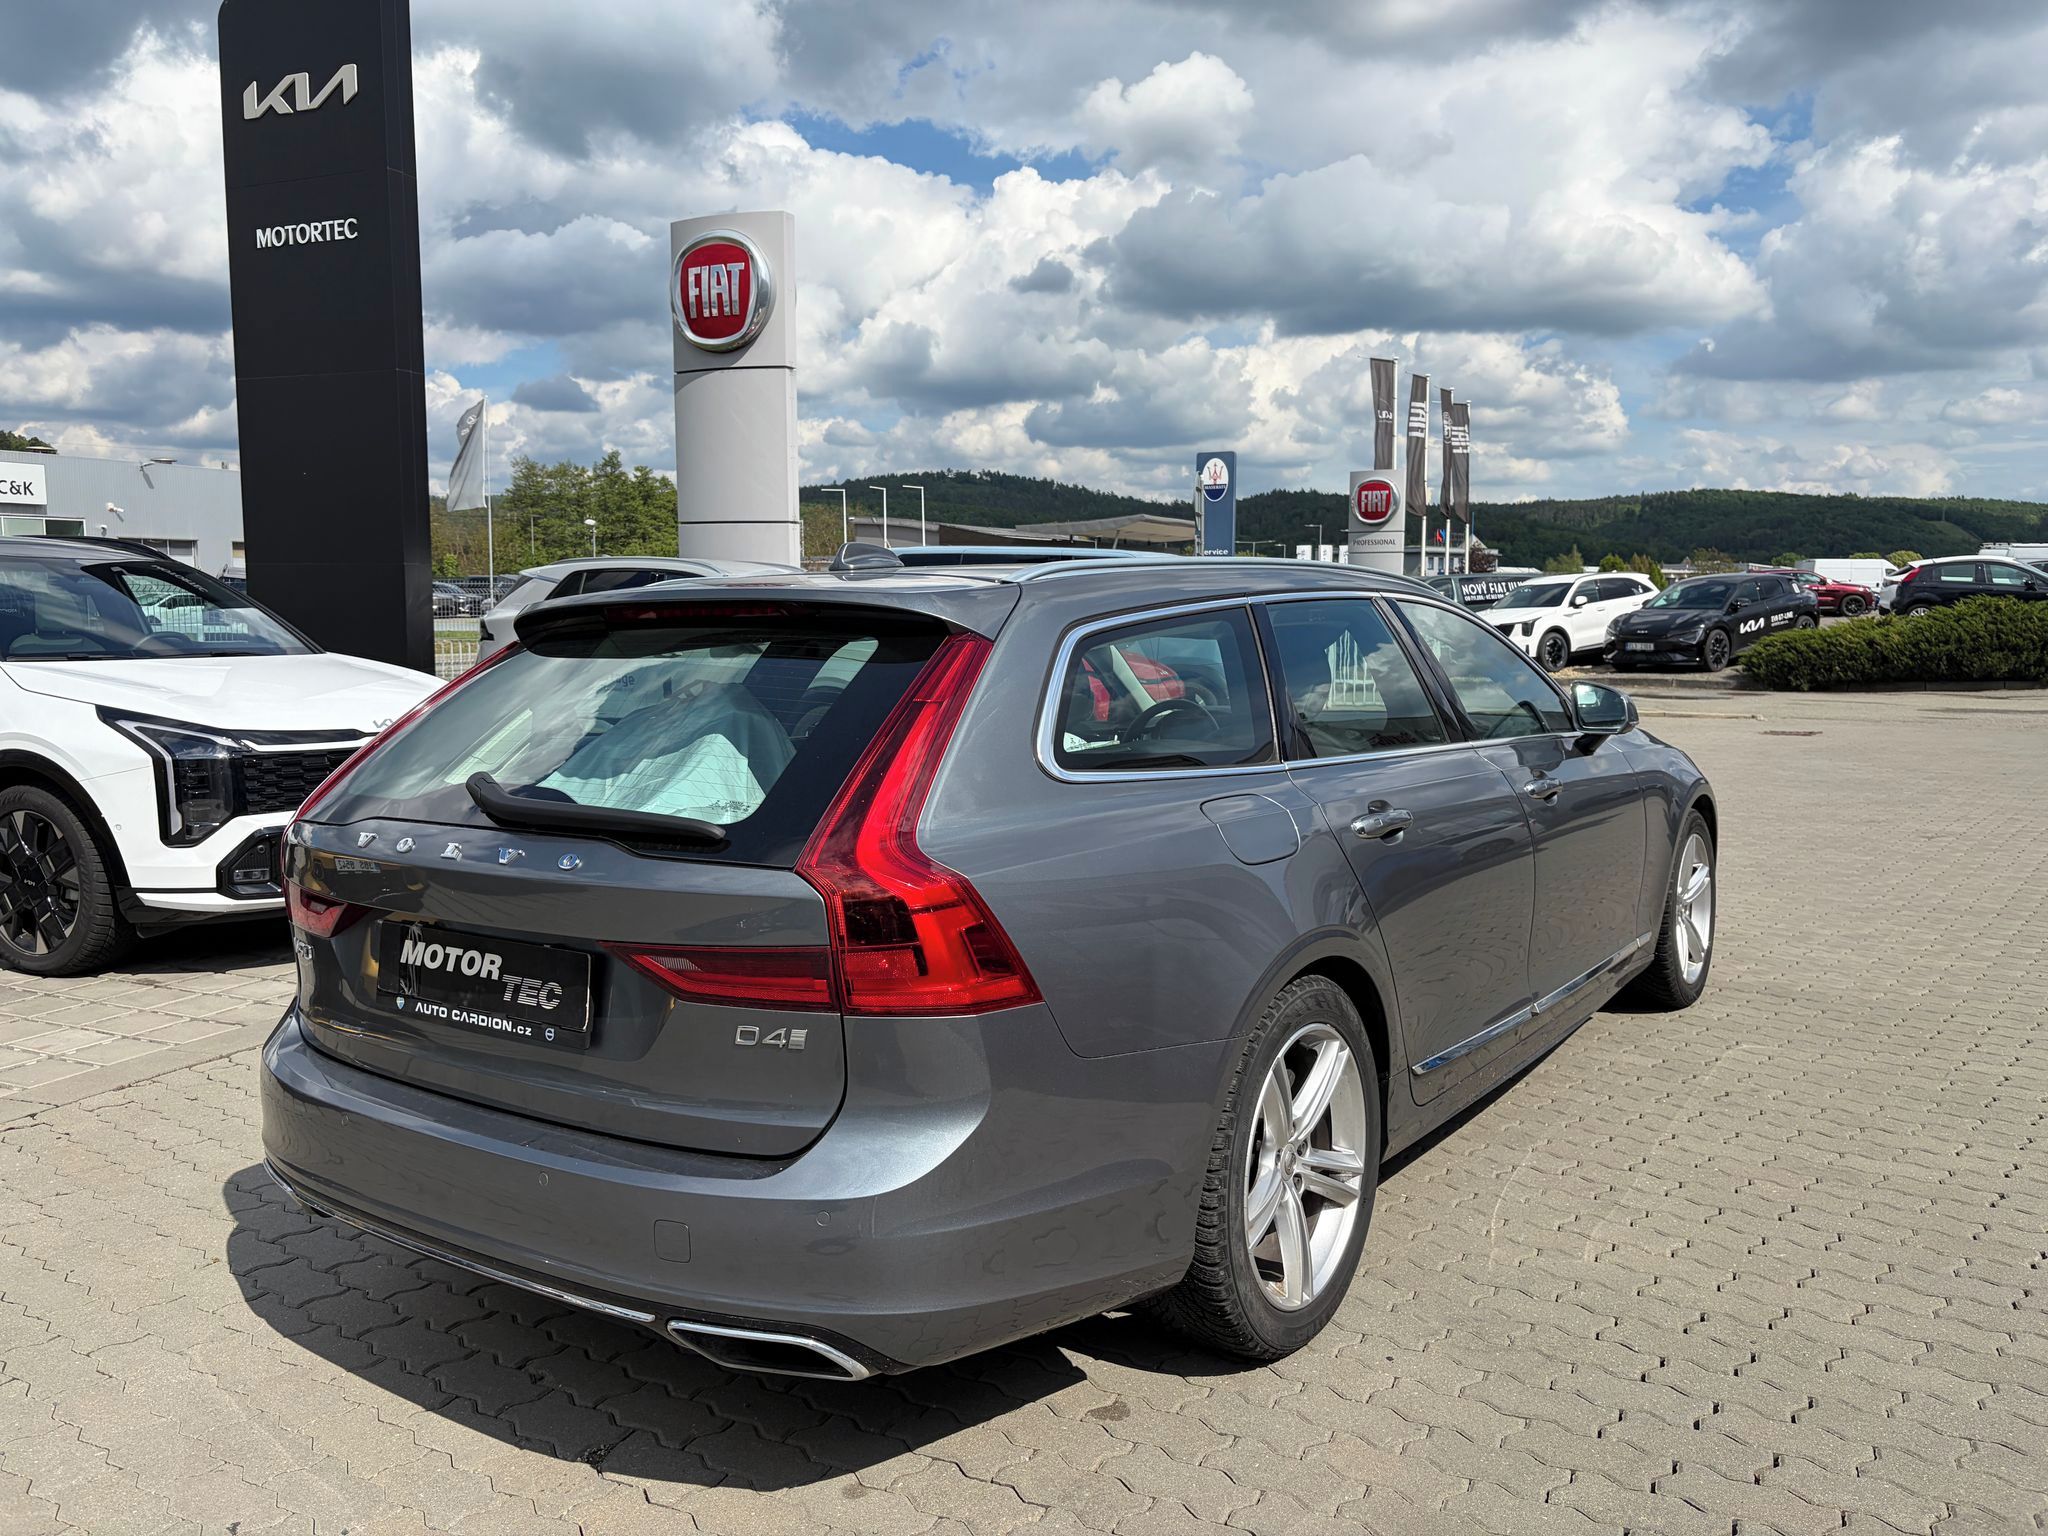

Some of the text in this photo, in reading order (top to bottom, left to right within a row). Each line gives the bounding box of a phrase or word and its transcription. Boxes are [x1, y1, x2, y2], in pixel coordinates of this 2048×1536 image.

[243, 64, 358, 120] KIA
[256, 218, 358, 249] MOTORTEC
[688, 262, 745, 319] FIAT
[1361, 490, 1389, 513] FIAT
[1204, 548, 1229, 556] ervice
[1461, 581, 1487, 596] NOVÝ
[1489, 582, 1508, 593] FIAT
[1740, 617, 1765, 634] KIA
[358, 831, 582, 871] VOLVO
[400, 939, 503, 981] MOTOR
[501, 974, 563, 1011] TEC
[415, 1001, 532, 1037] AUTO CARDION.cz
